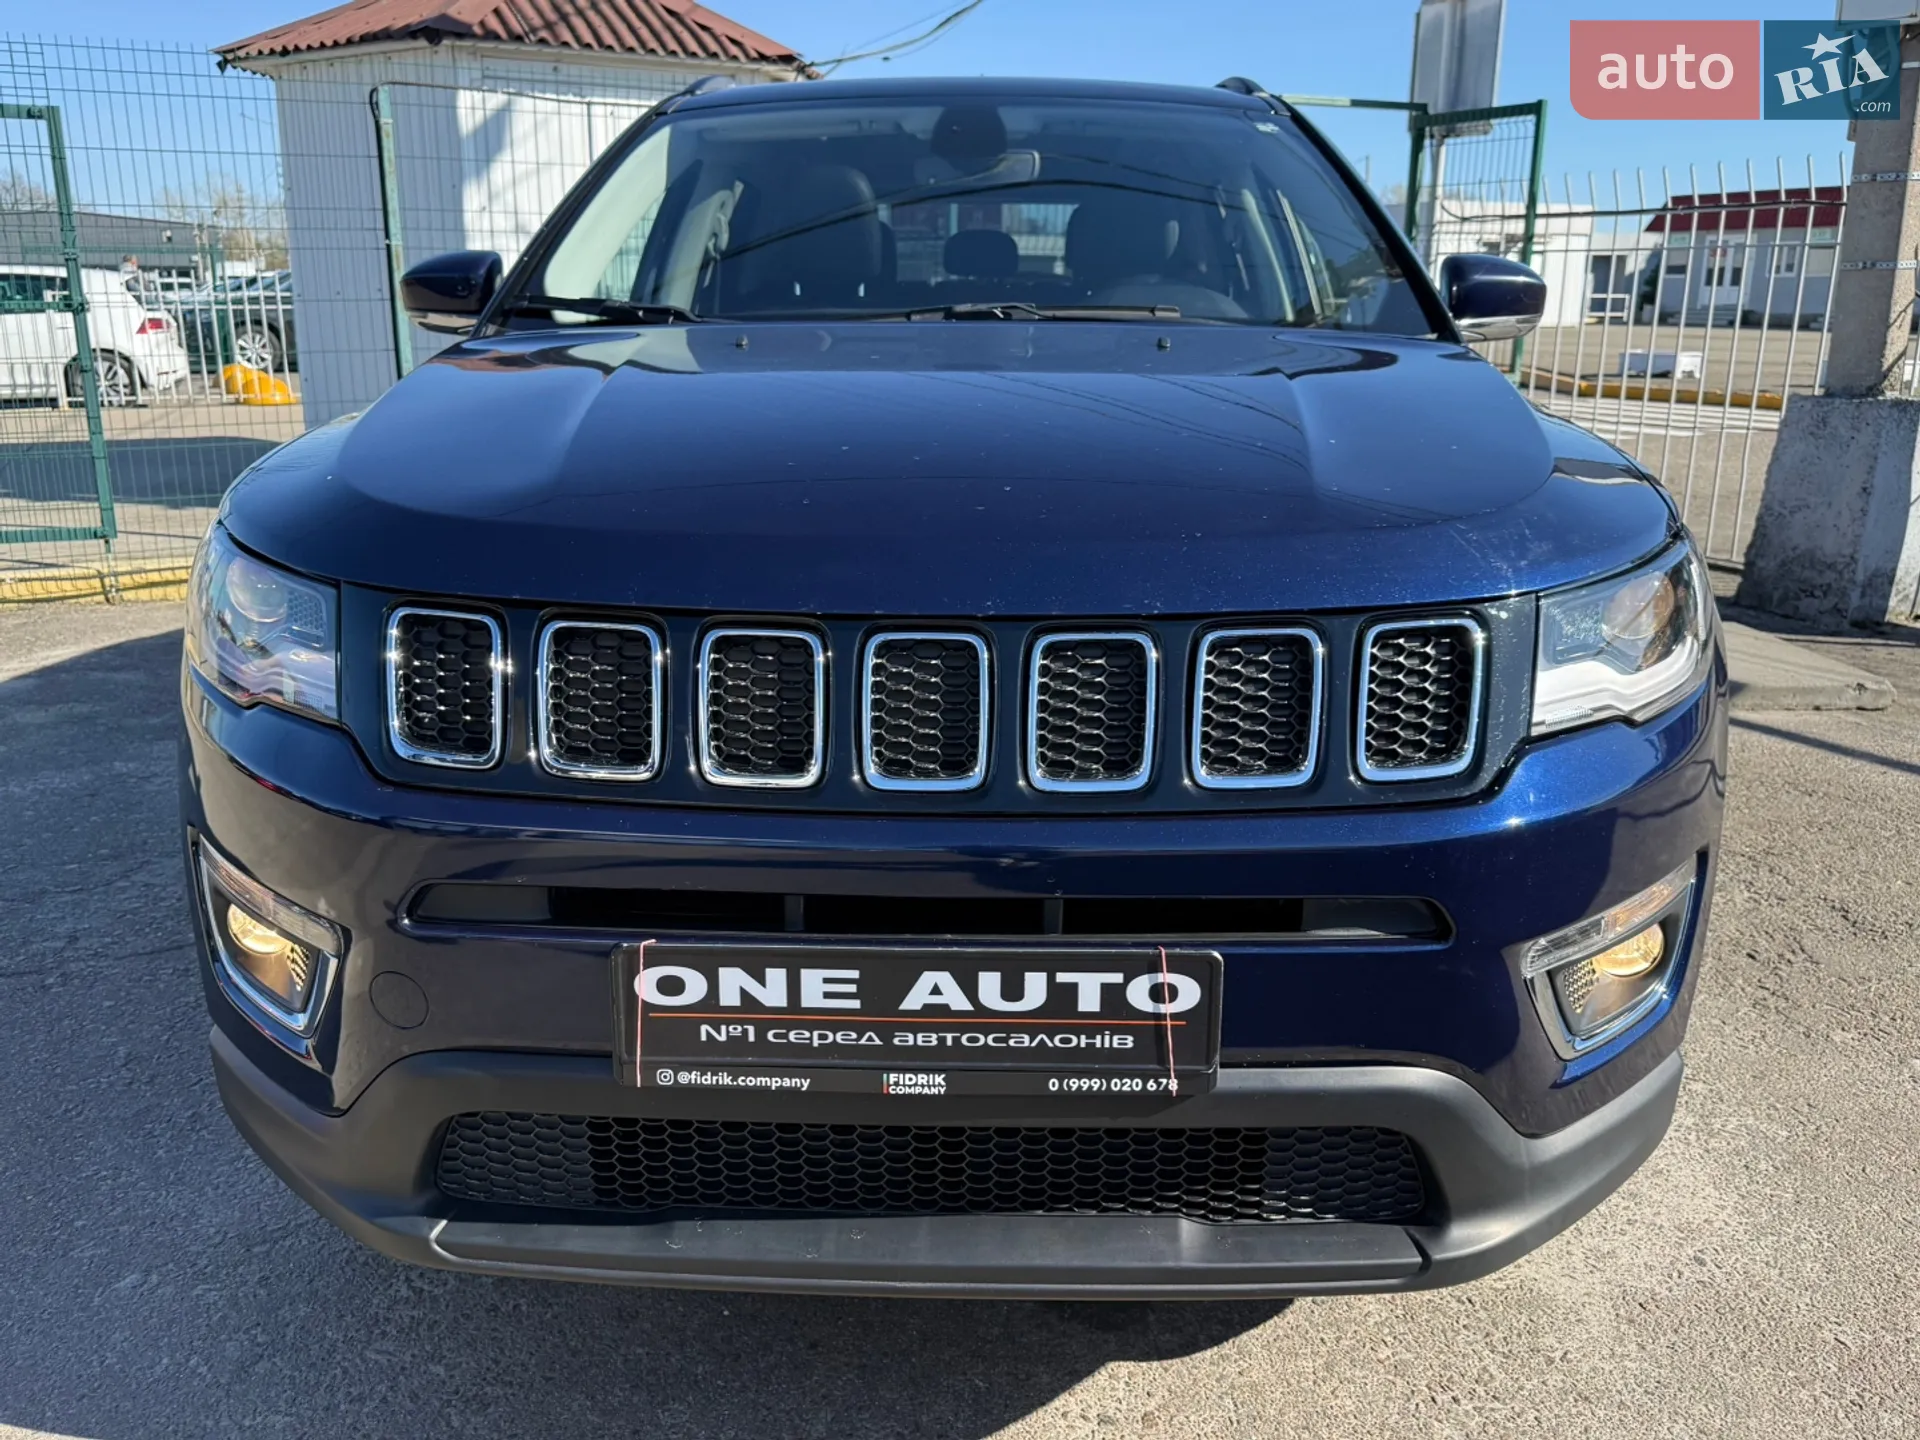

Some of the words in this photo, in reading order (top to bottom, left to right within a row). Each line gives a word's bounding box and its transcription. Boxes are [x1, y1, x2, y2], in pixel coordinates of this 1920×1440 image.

[634, 965, 861, 1009] ONE
[898, 971, 1201, 1014] AUTO
[767, 1028, 883, 1047] серед
[893, 1030, 1134, 1048] автосалонів
[677, 1070, 811, 1091] @fidrik.company
[889, 1074, 946, 1086] FIDRIK
[1048, 1078, 1059, 1091] 0
[1063, 1078, 1107, 1092] (999)
[1110, 1079, 1142, 1091] 020
[1146, 1079, 1179, 1092] 678
[889, 1085, 947, 1095] COMPANY
